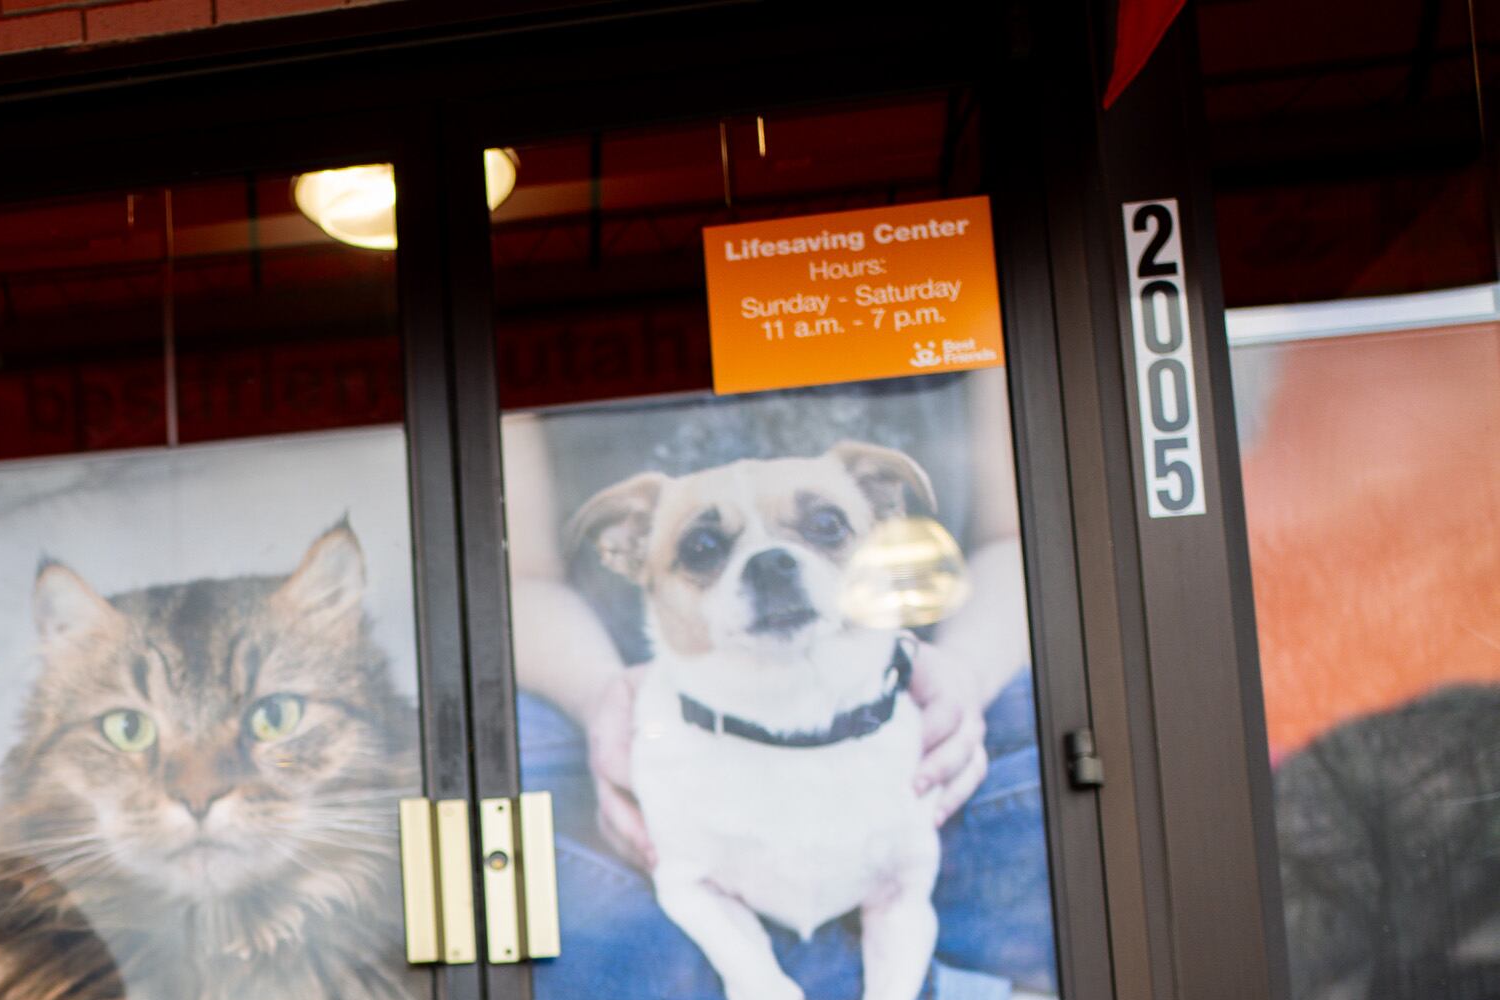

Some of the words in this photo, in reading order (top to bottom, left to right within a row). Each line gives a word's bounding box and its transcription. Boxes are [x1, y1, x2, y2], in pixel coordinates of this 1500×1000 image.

[725, 229, 866, 261] Lifesaving
[873, 218, 970, 245] Center
[808, 257, 888, 282] Hours:
[740, 292, 830, 319] Sunday
[854, 278, 963, 307] Saturday
[761, 320, 785, 341] 11
[793, 316, 846, 338] a.m.
[871, 308, 887, 330] 7
[893, 306, 947, 332] p.m.
[942, 338, 977, 351] Best
[942, 348, 998, 364] Friends
[1131, 203, 1195, 512] 2005
